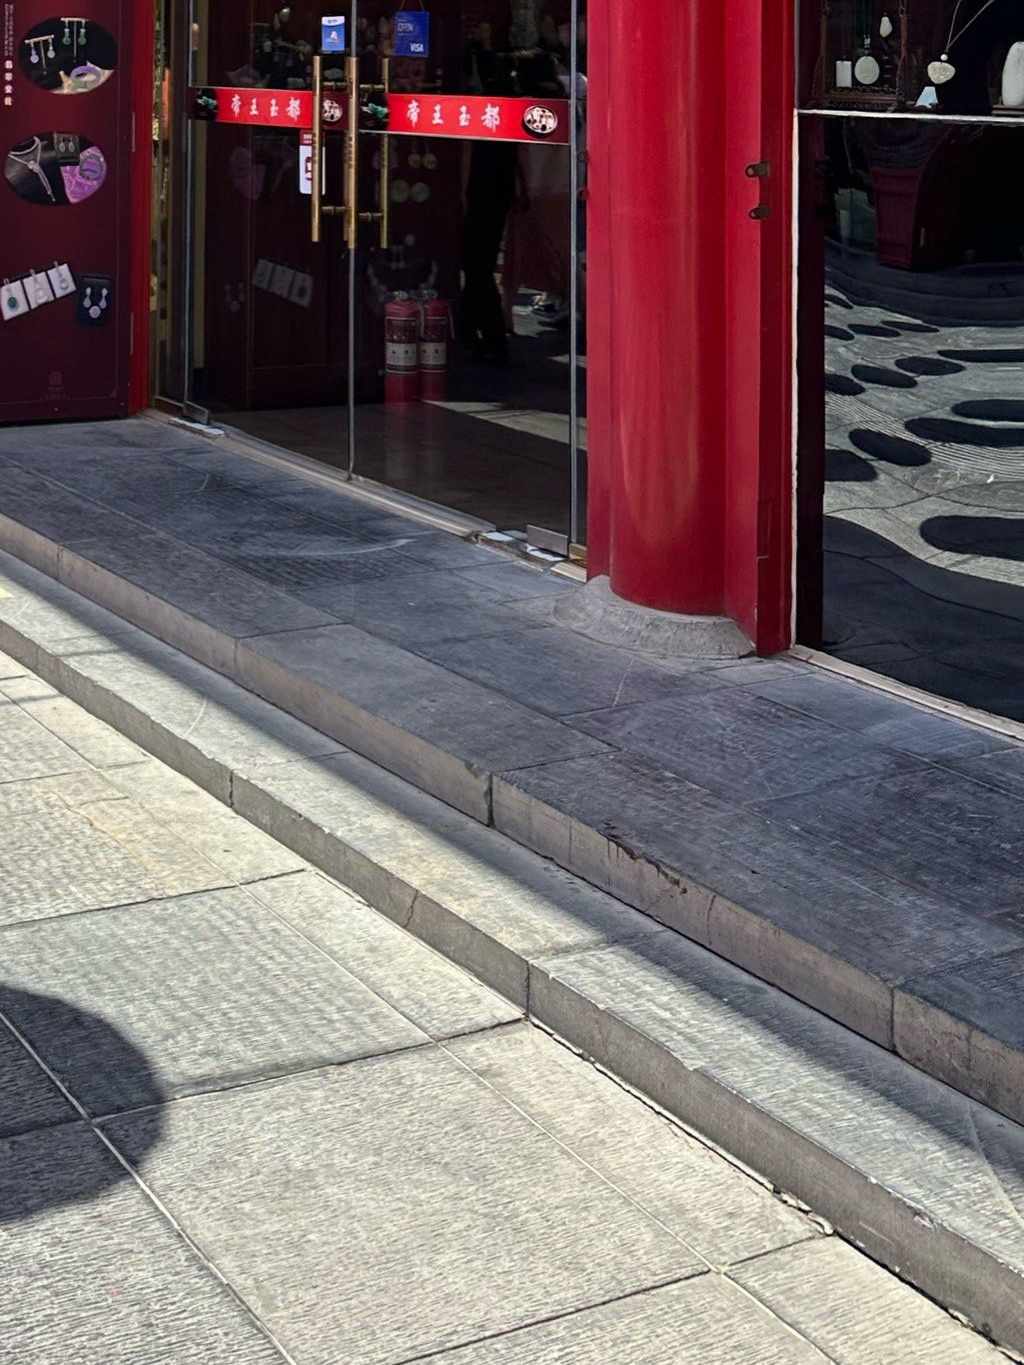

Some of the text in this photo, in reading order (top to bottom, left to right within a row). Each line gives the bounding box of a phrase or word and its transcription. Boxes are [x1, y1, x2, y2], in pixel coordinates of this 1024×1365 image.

[410, 42, 424, 53] VISA
[230, 93, 302, 122] 帝王玉都
[406, 99, 501, 133] 帝王玉都
